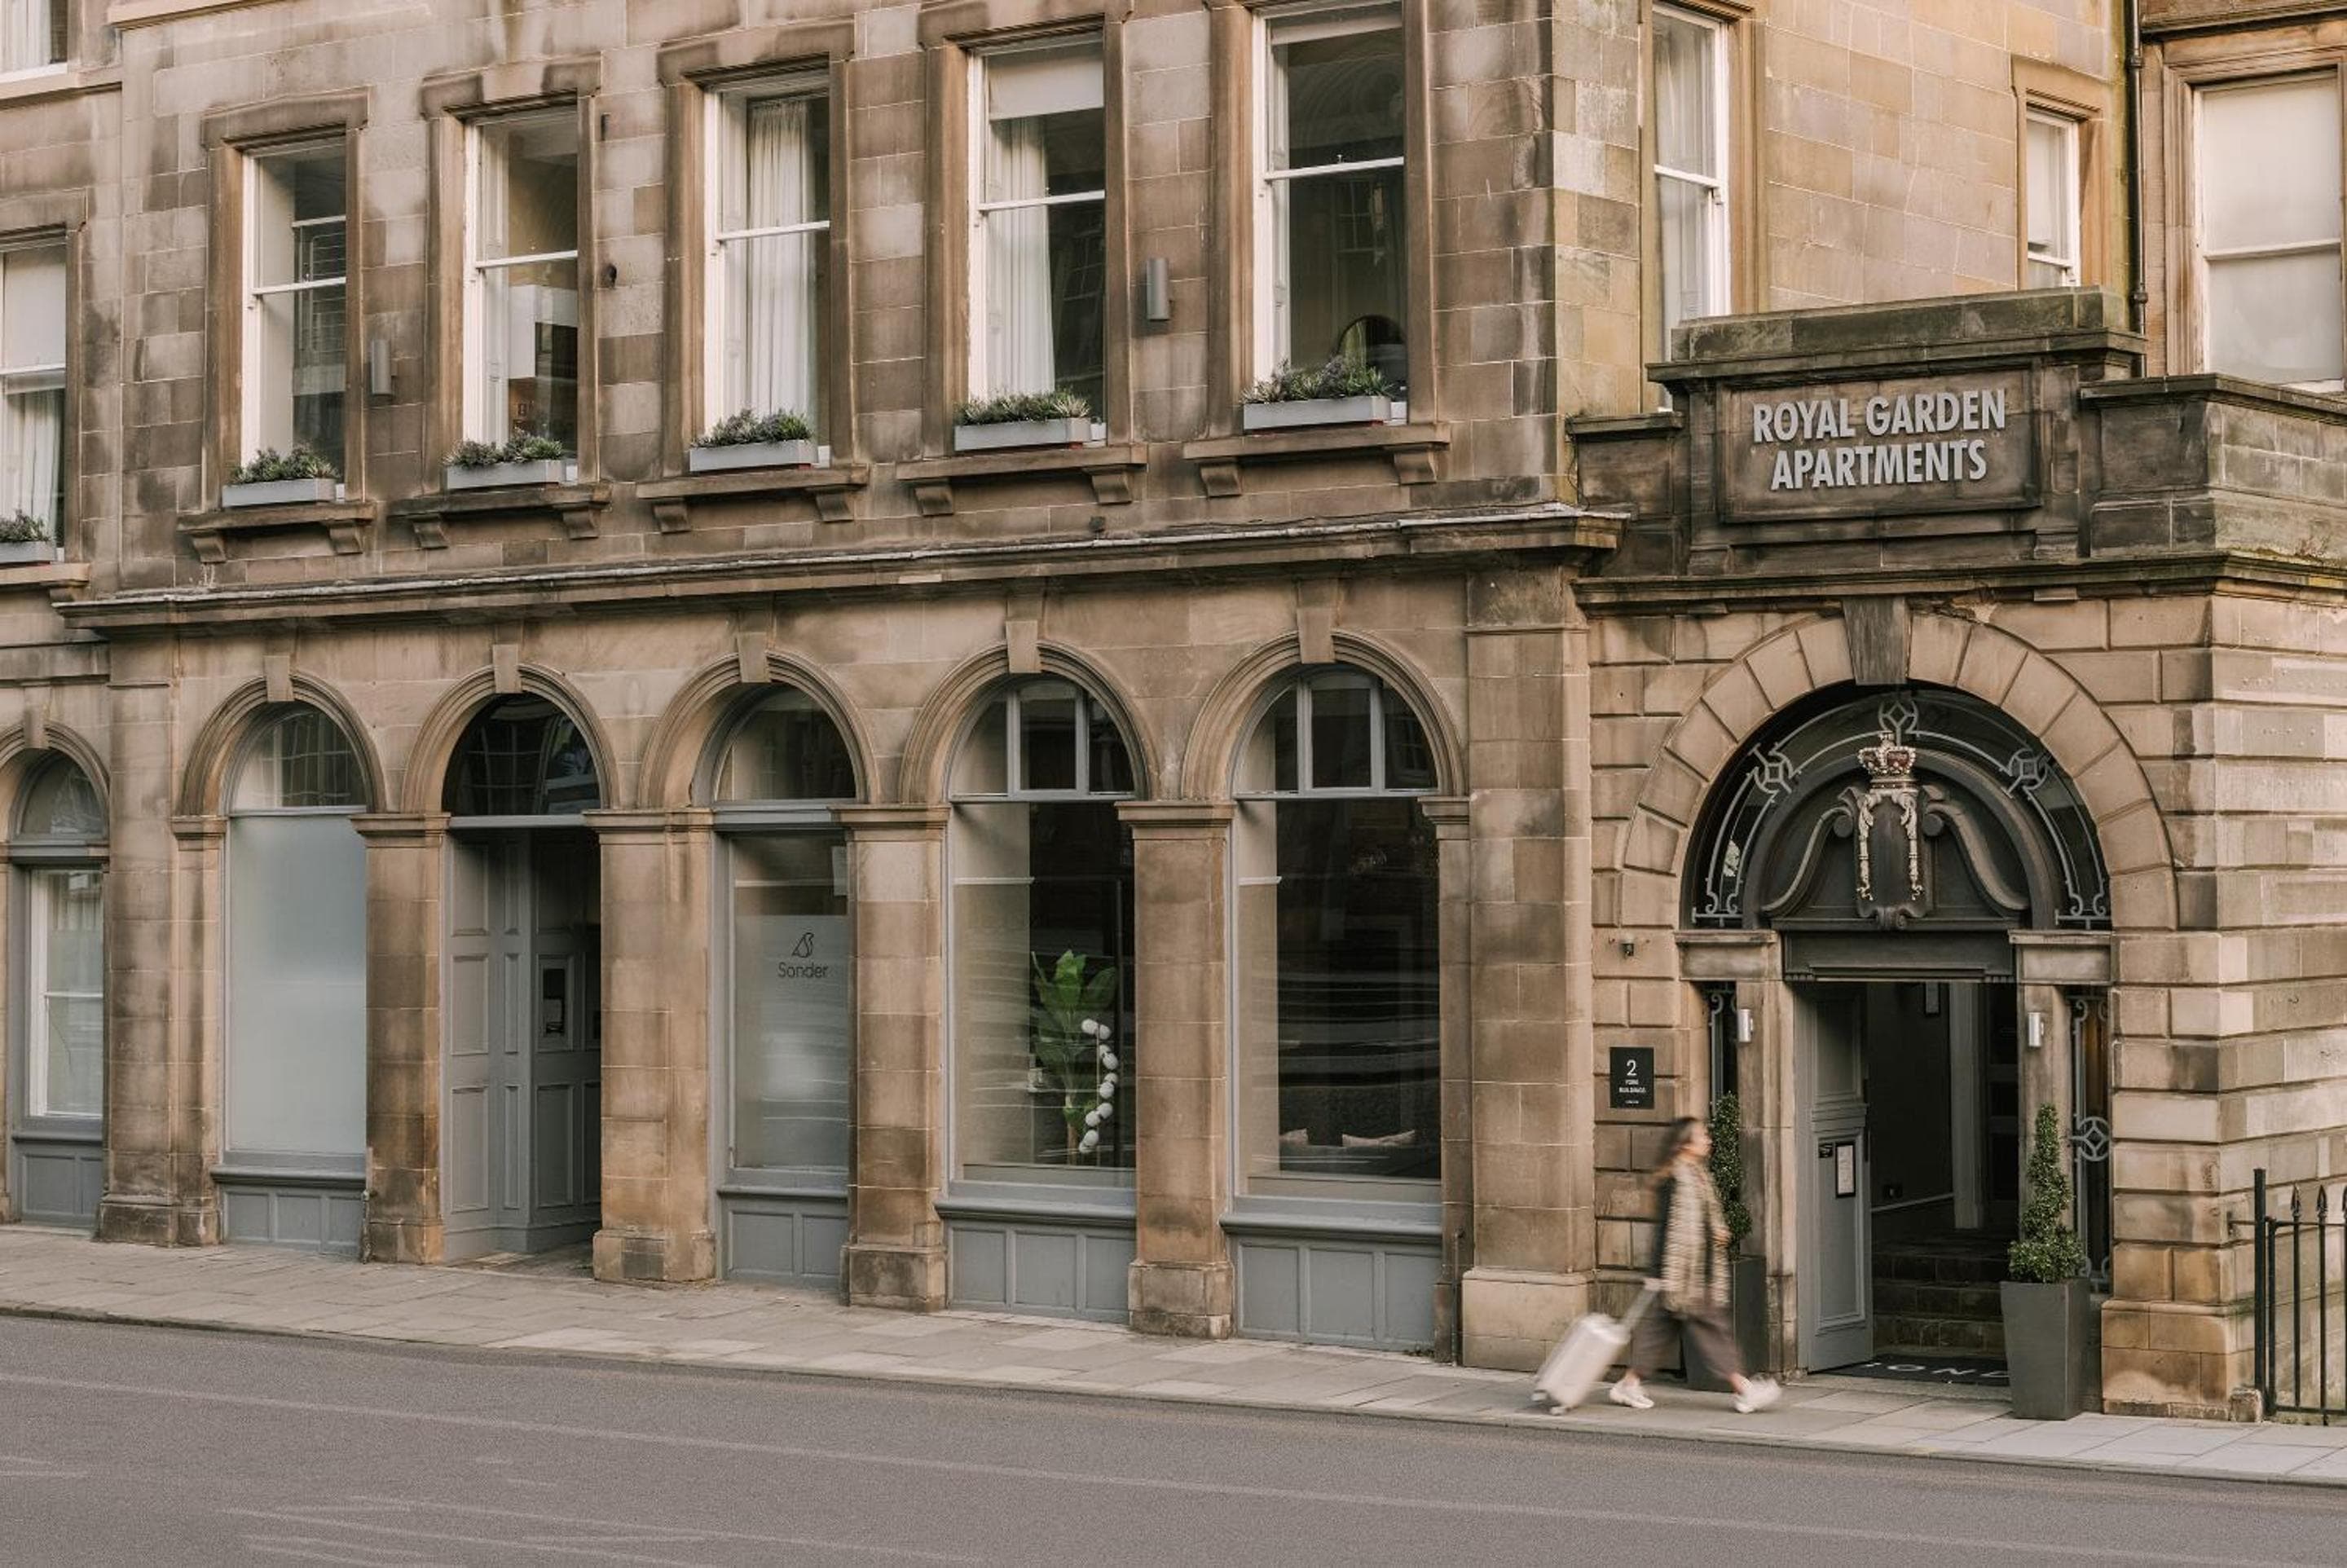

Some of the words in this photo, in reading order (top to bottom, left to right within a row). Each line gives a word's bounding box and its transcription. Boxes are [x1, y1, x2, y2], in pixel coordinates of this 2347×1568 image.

[1753, 399, 1856, 443] ROYAL
[1866, 389, 2006, 436] GARDEN
[1771, 438, 1987, 491] APARTMENTS
[777, 962, 828, 978] Sonder
[1627, 1059, 1636, 1076] 2
